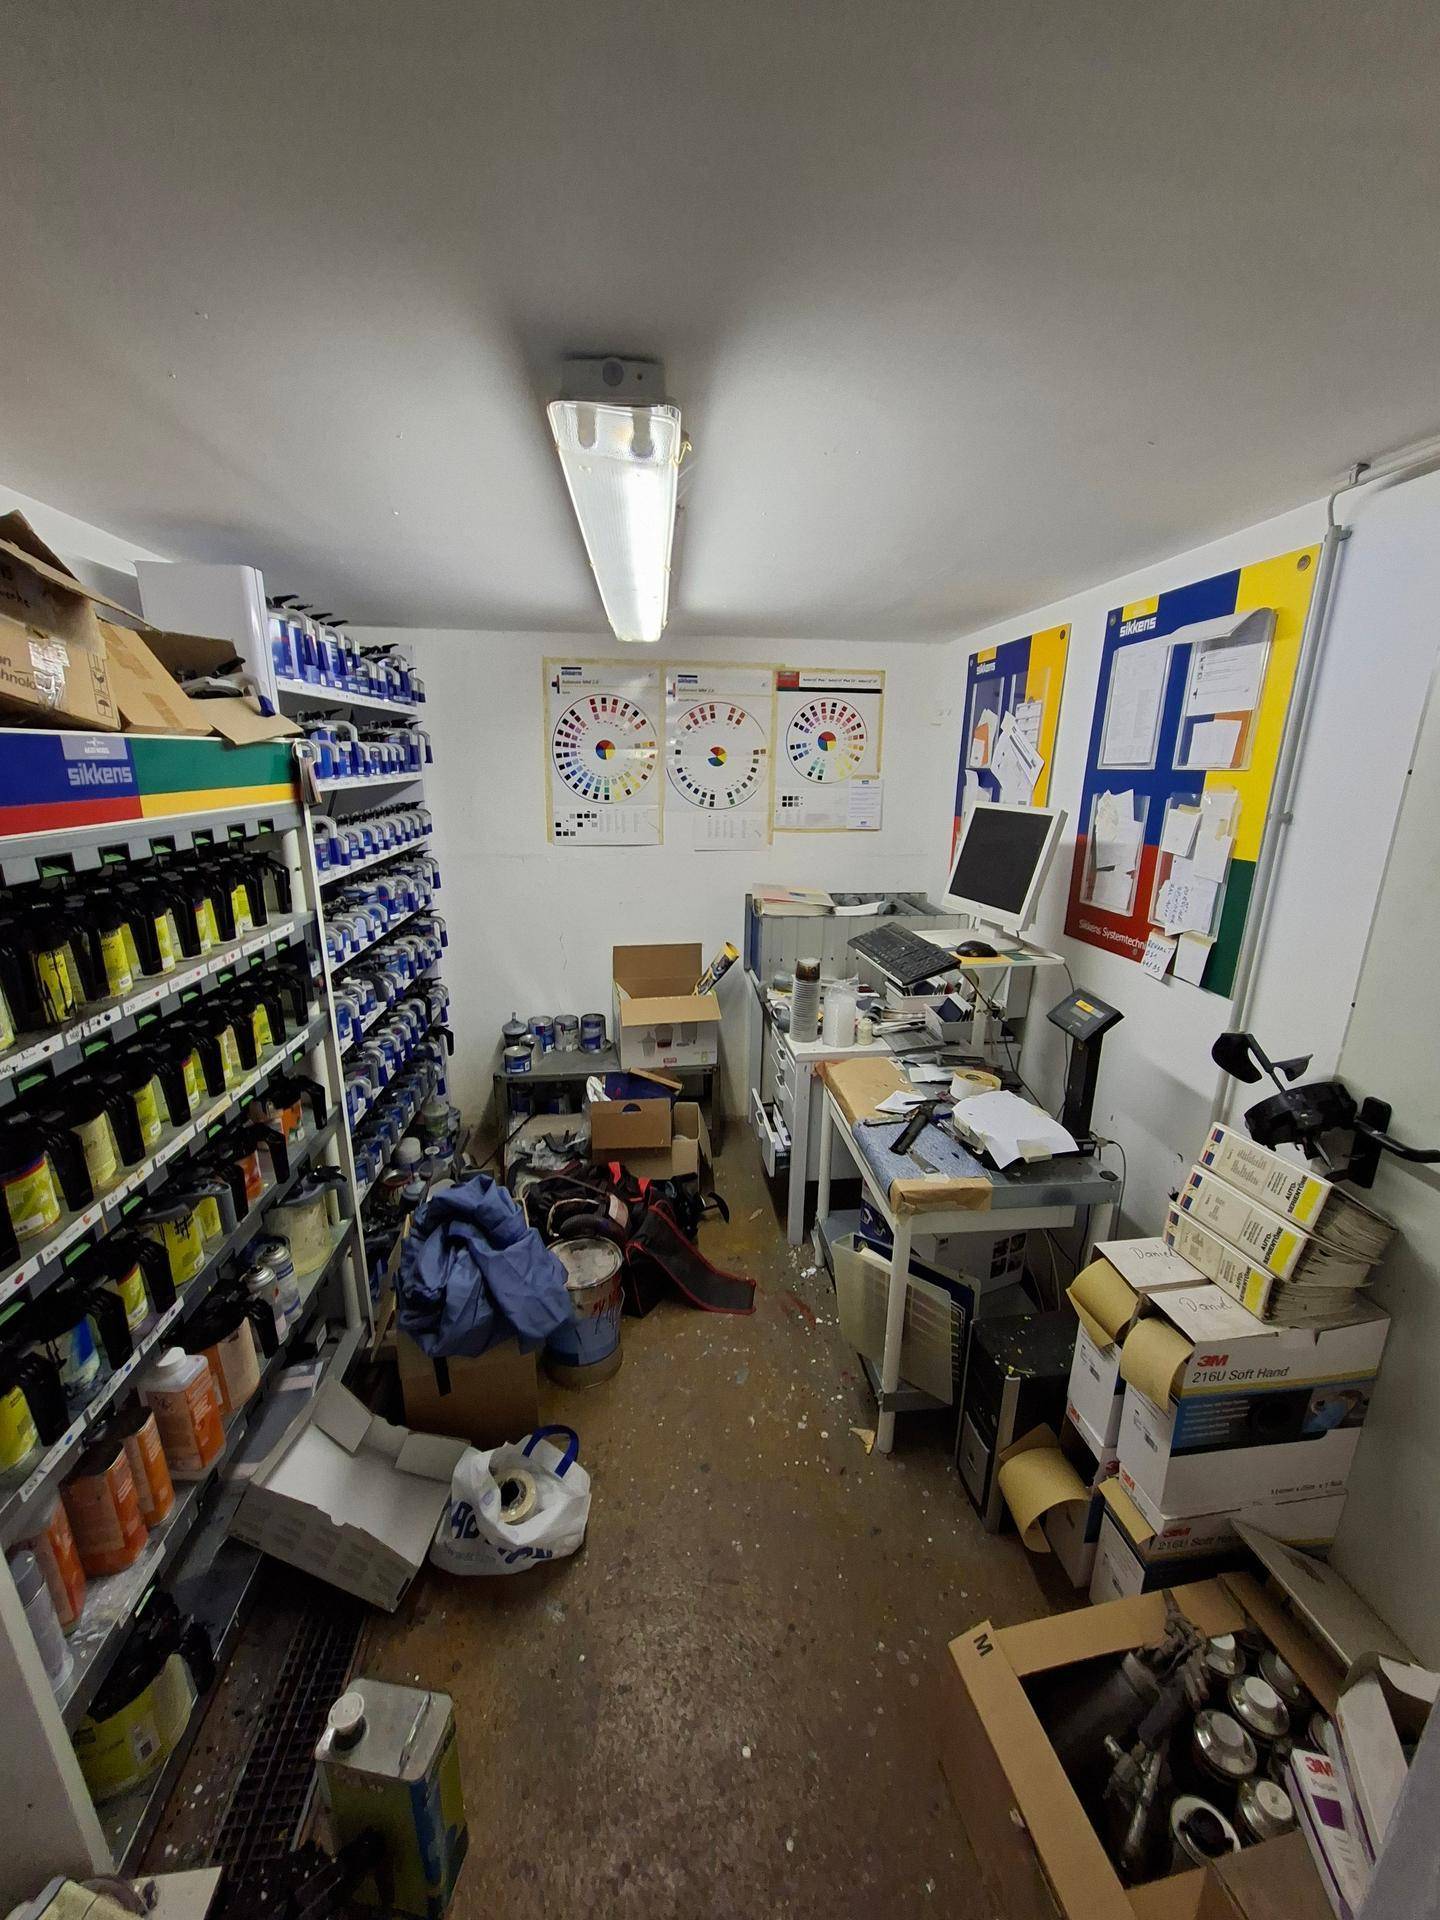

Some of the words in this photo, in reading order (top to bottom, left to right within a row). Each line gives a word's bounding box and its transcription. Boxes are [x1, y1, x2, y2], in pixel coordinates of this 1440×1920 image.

[1119, 616, 1156, 637] sikkens
[67, 762, 133, 786] sikkens
[1197, 1354, 1229, 1368] 3M
[1192, 1370, 1227, 1384] 216U
[1228, 1368, 1255, 1381] Soft
[1256, 1366, 1290, 1379] Hand
[972, 1632, 994, 1657] M
[1304, 1756, 1334, 1777] 3M
